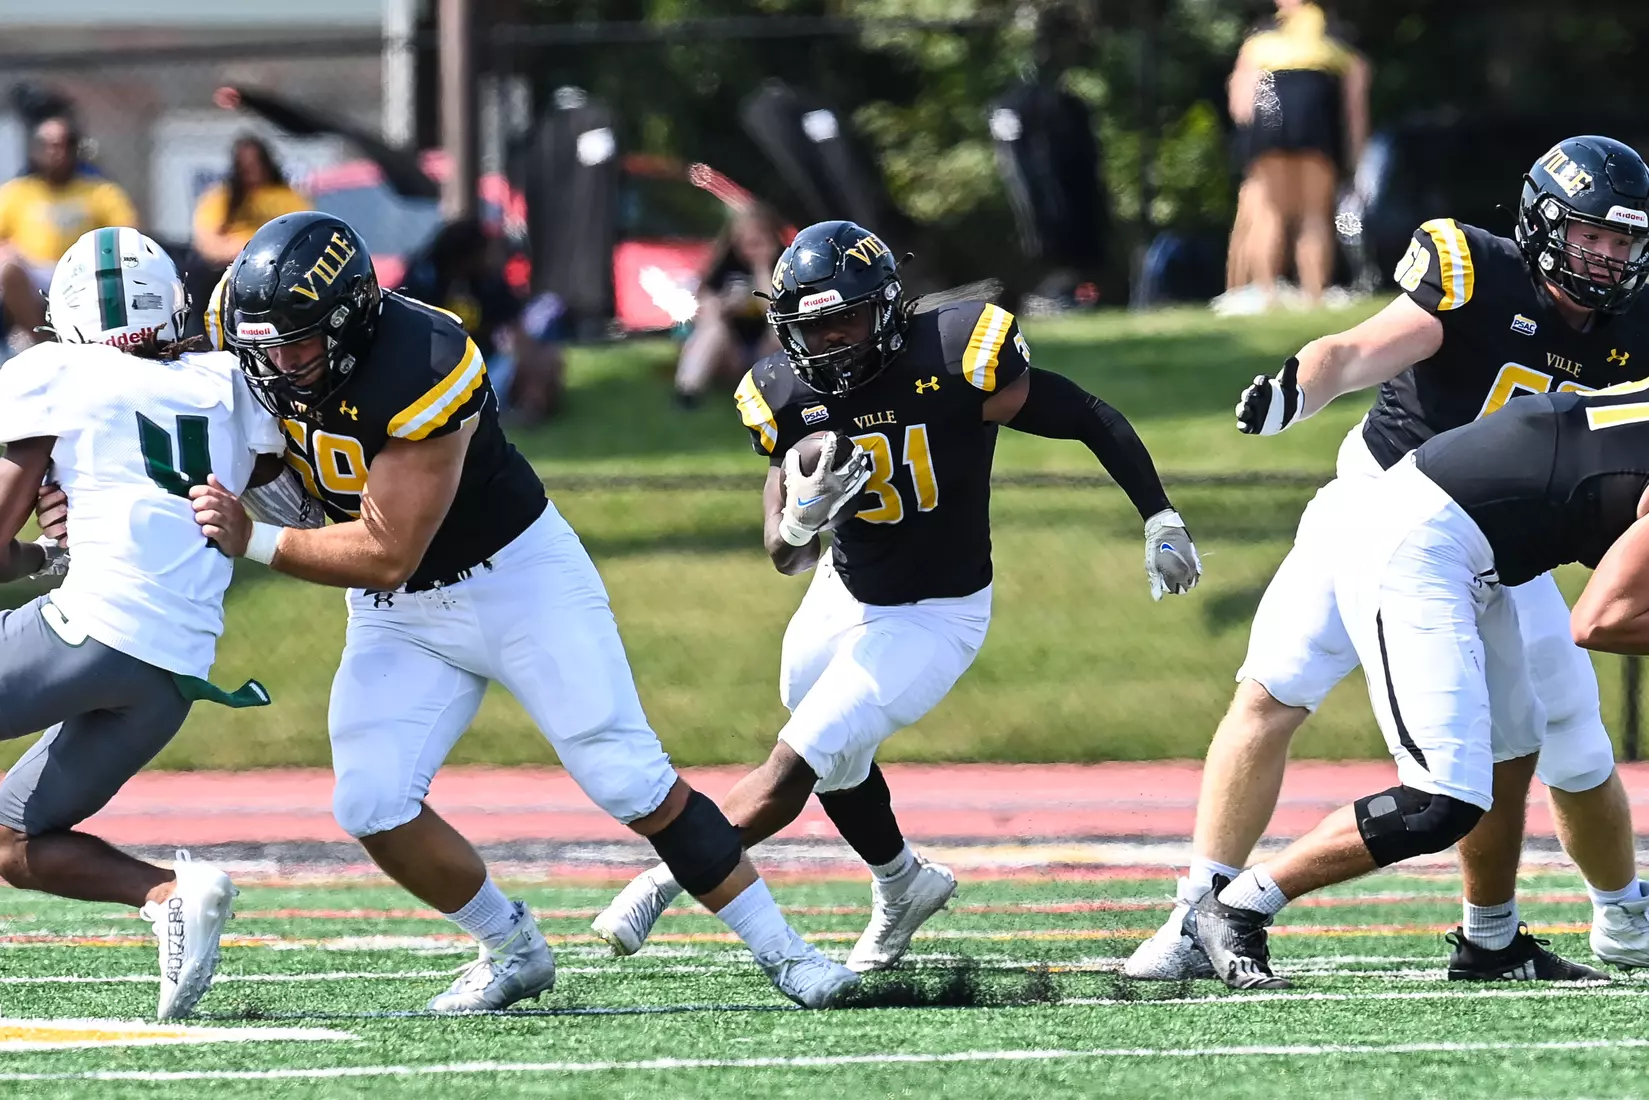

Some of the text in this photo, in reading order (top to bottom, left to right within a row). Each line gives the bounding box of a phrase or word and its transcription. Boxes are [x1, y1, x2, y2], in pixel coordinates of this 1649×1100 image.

[1538, 145, 1594, 198] VILLE
[289, 231, 356, 300] VILLE
[803, 295, 836, 307] Riddell
[1513, 319, 1536, 332] PSAC
[1546, 352, 1583, 378] VILLE
[804, 408, 827, 421] PSAC
[853, 410, 897, 429] VILLE
[848, 423, 940, 525] 31
